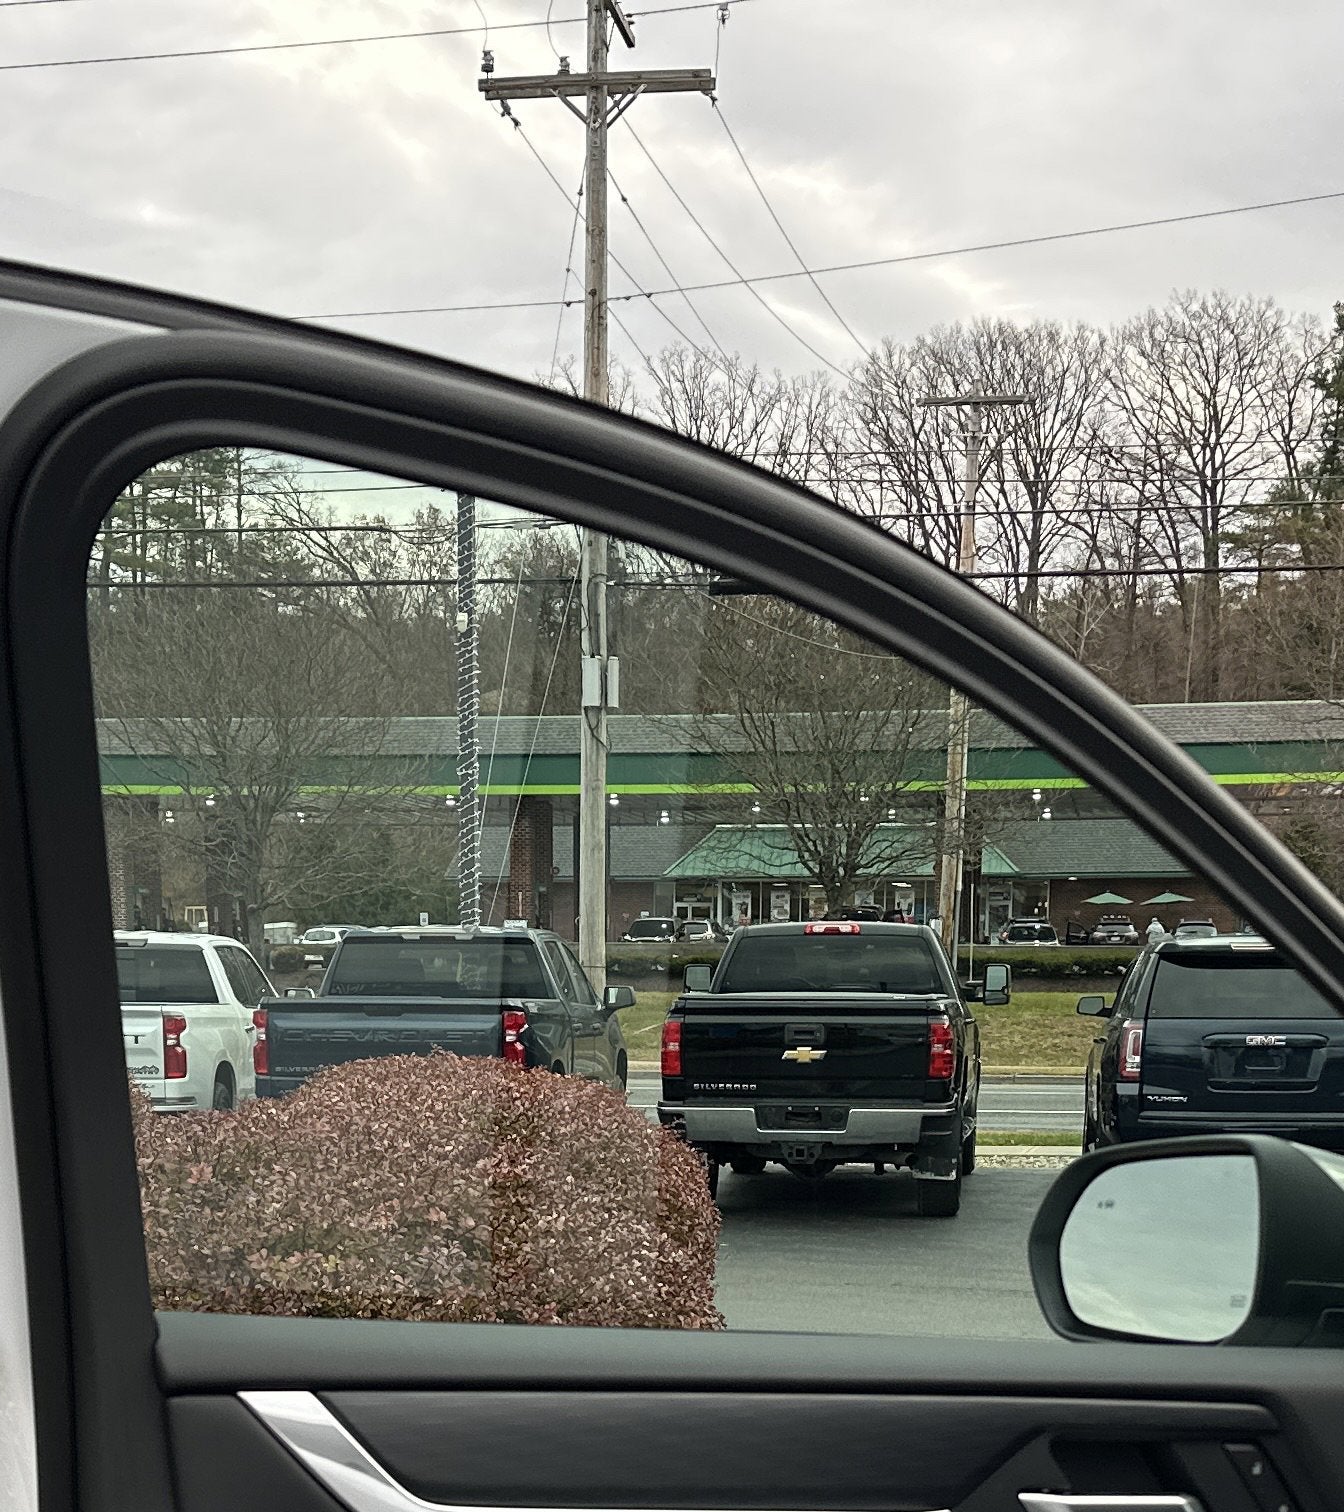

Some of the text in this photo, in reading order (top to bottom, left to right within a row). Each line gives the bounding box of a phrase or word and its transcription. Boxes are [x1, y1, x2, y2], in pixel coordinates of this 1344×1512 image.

[283, 1029, 486, 1042] CHEVROLET
[1245, 1035, 1287, 1046] GMC
[1146, 1095, 1188, 1103] YUKON
